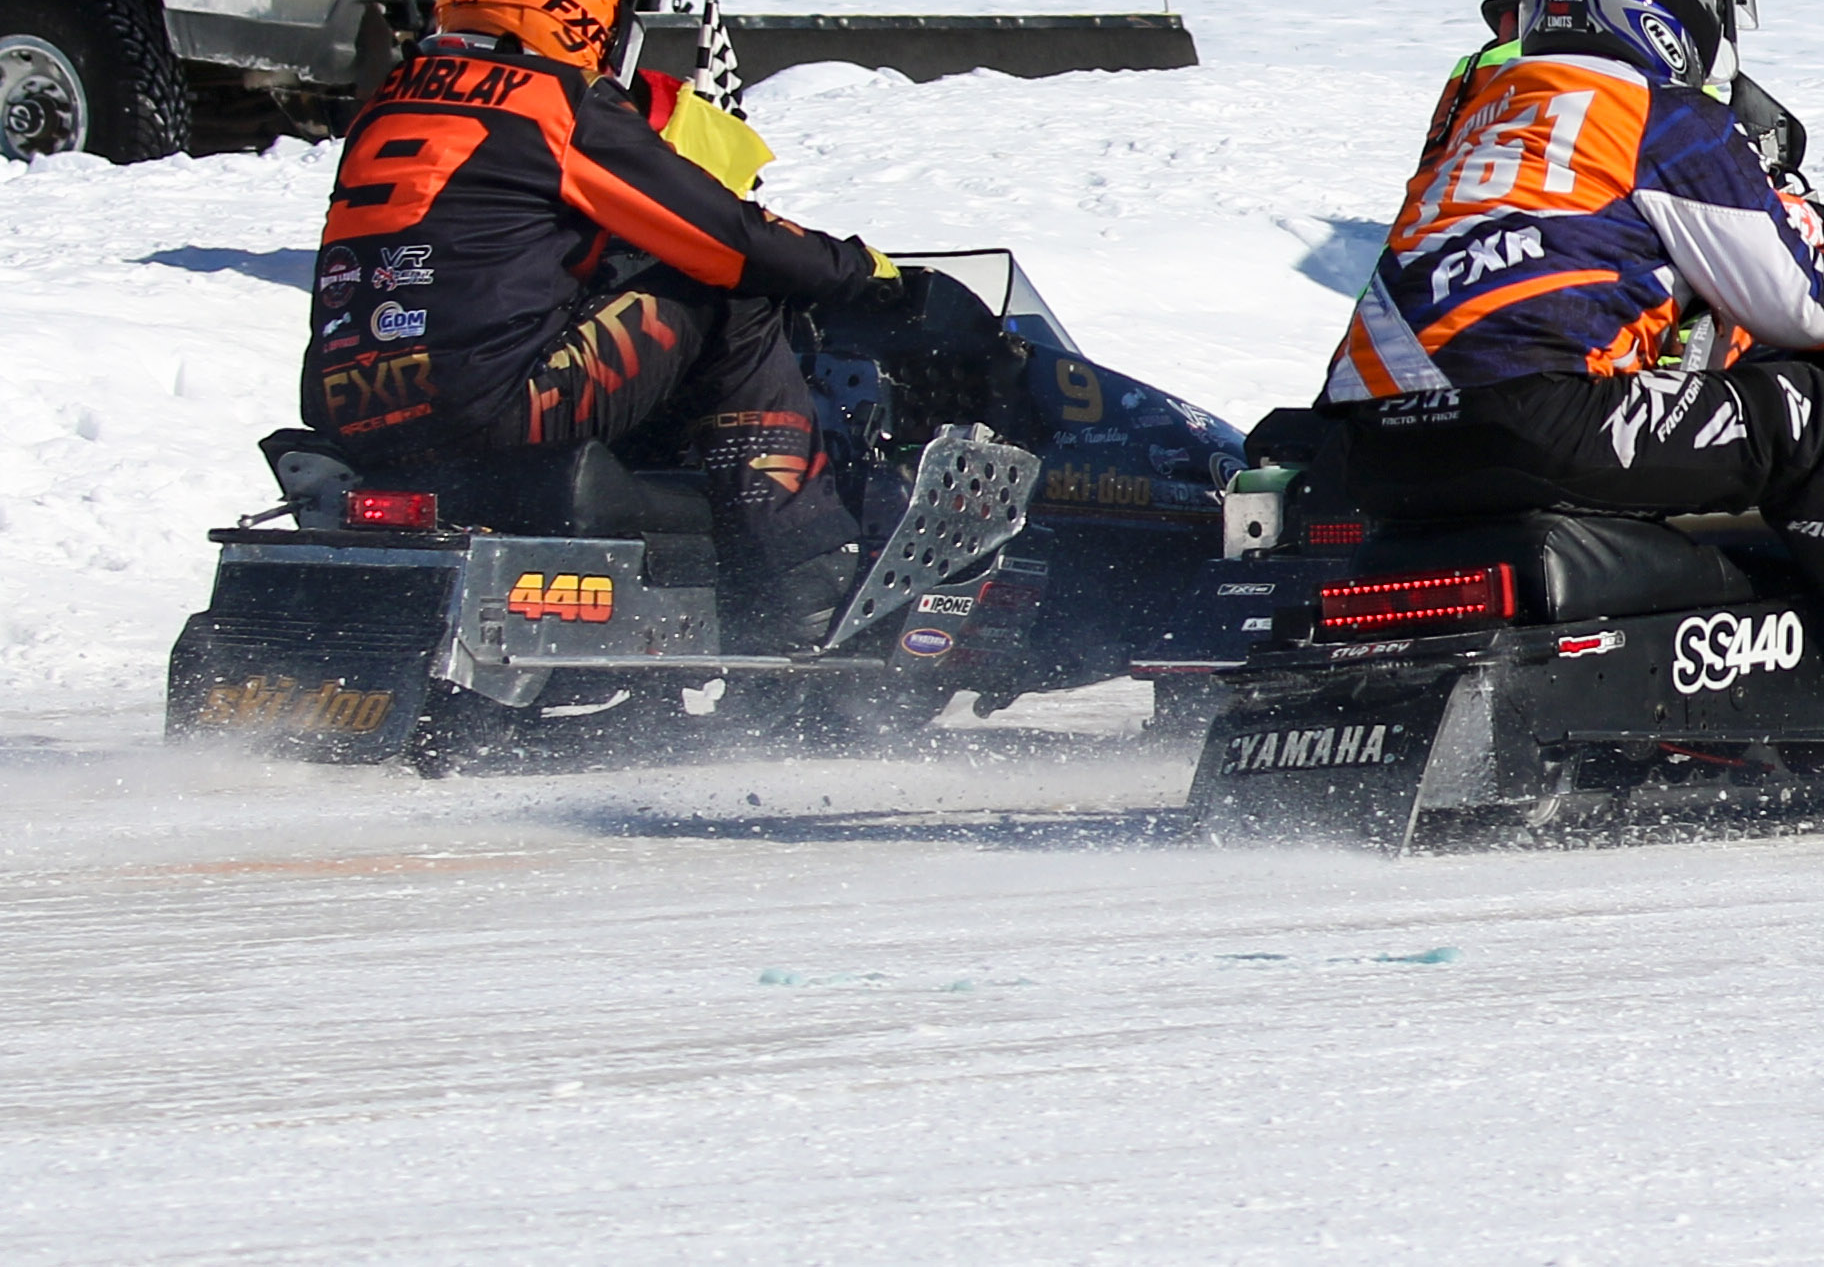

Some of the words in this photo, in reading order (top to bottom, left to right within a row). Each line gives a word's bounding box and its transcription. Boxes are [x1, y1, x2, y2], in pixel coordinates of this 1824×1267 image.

[1547, 16, 1573, 28] LIMITS
[1648, 25, 1685, 66] HJC
[322, 113, 489, 245] 9
[381, 245, 432, 267] VR
[1431, 225, 1545, 304] FXR
[382, 313, 425, 329] GDM
[323, 353, 438, 421] FXR
[1056, 359, 1103, 423] 9
[1382, 415, 1428, 426] FACTOY
[508, 572, 614, 623] 440
[931, 597, 973, 614] IPONE
[1330, 646, 1369, 660] STUD
[1374, 642, 1410, 655] BOY
[1236, 724, 1388, 772] YAMAHA
